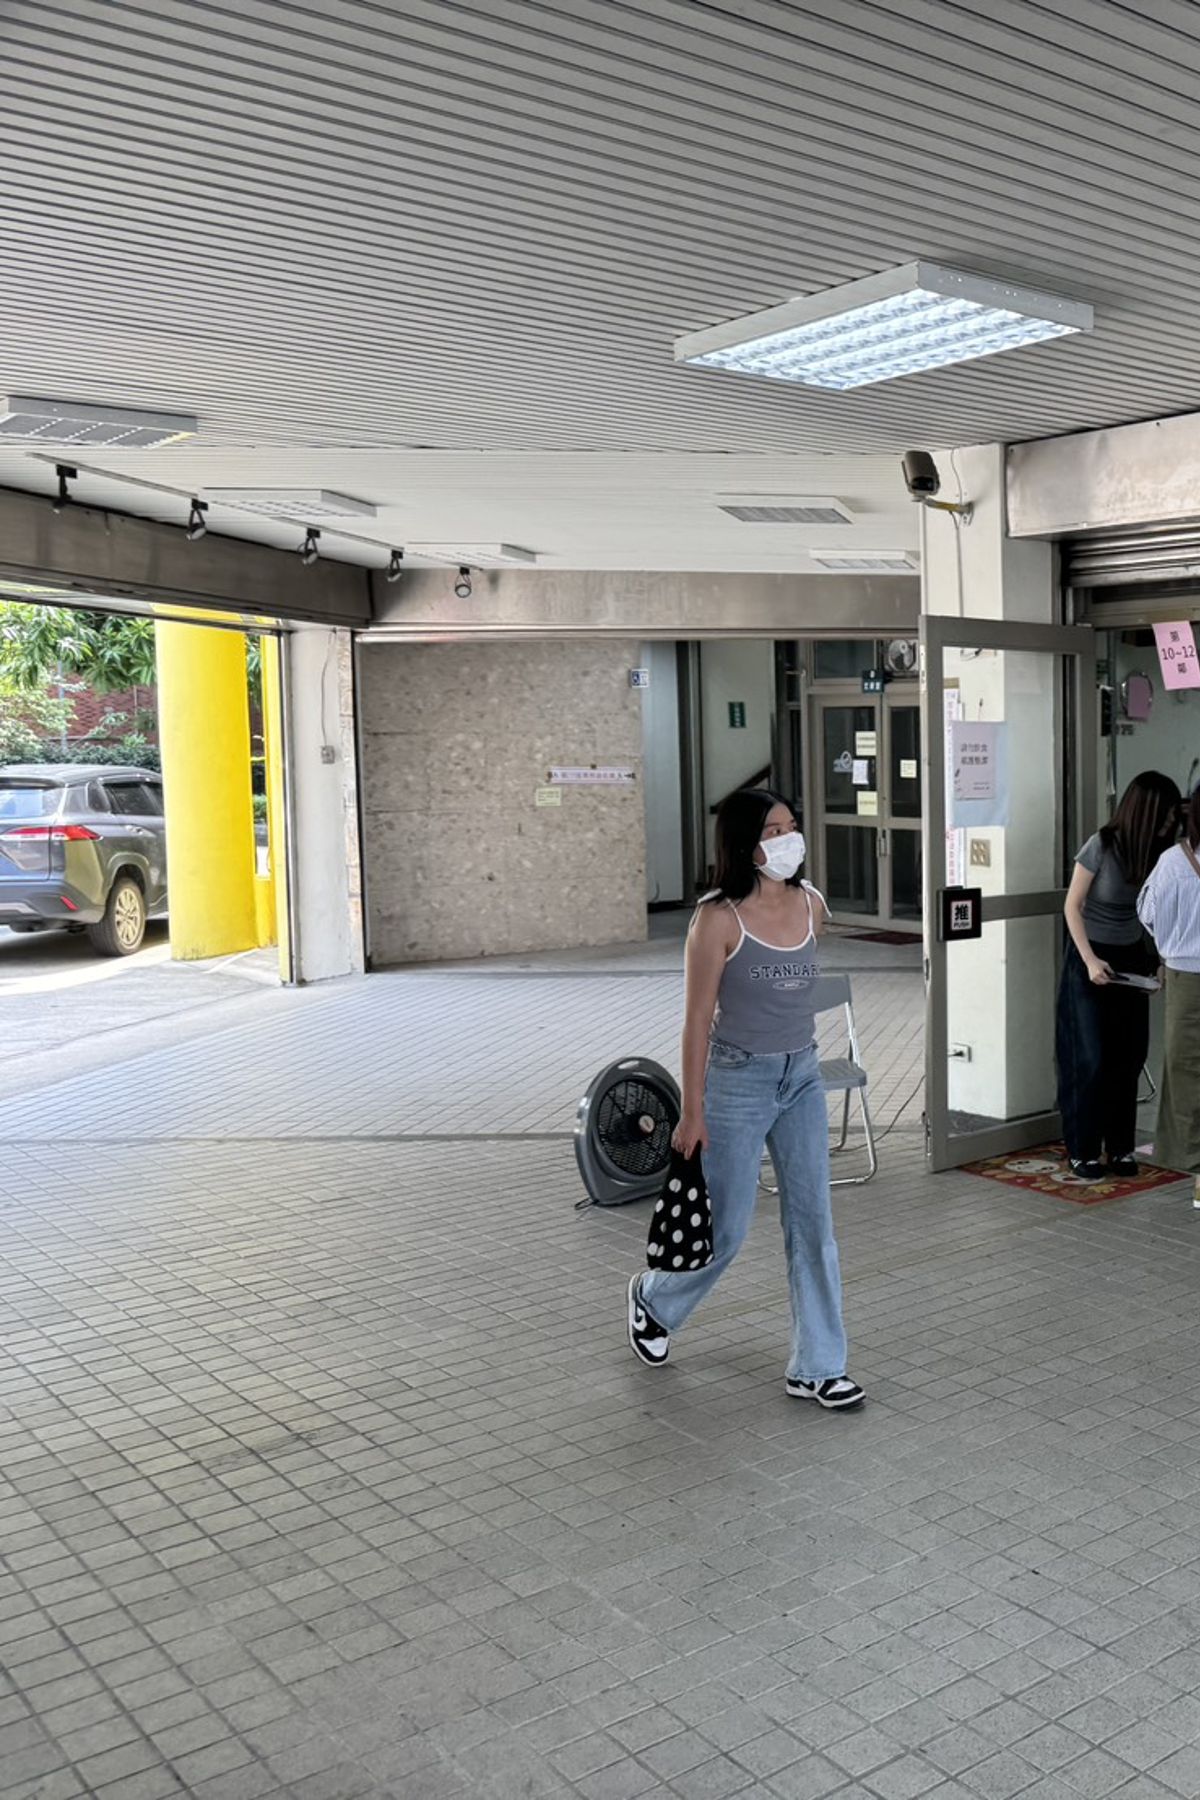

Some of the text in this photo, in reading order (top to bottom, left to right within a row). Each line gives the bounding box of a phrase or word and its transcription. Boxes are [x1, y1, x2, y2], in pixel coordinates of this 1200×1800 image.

[1170, 631, 1180, 641] 第
[1161, 645, 1195, 660] 10~12
[954, 904, 969, 921] 推
